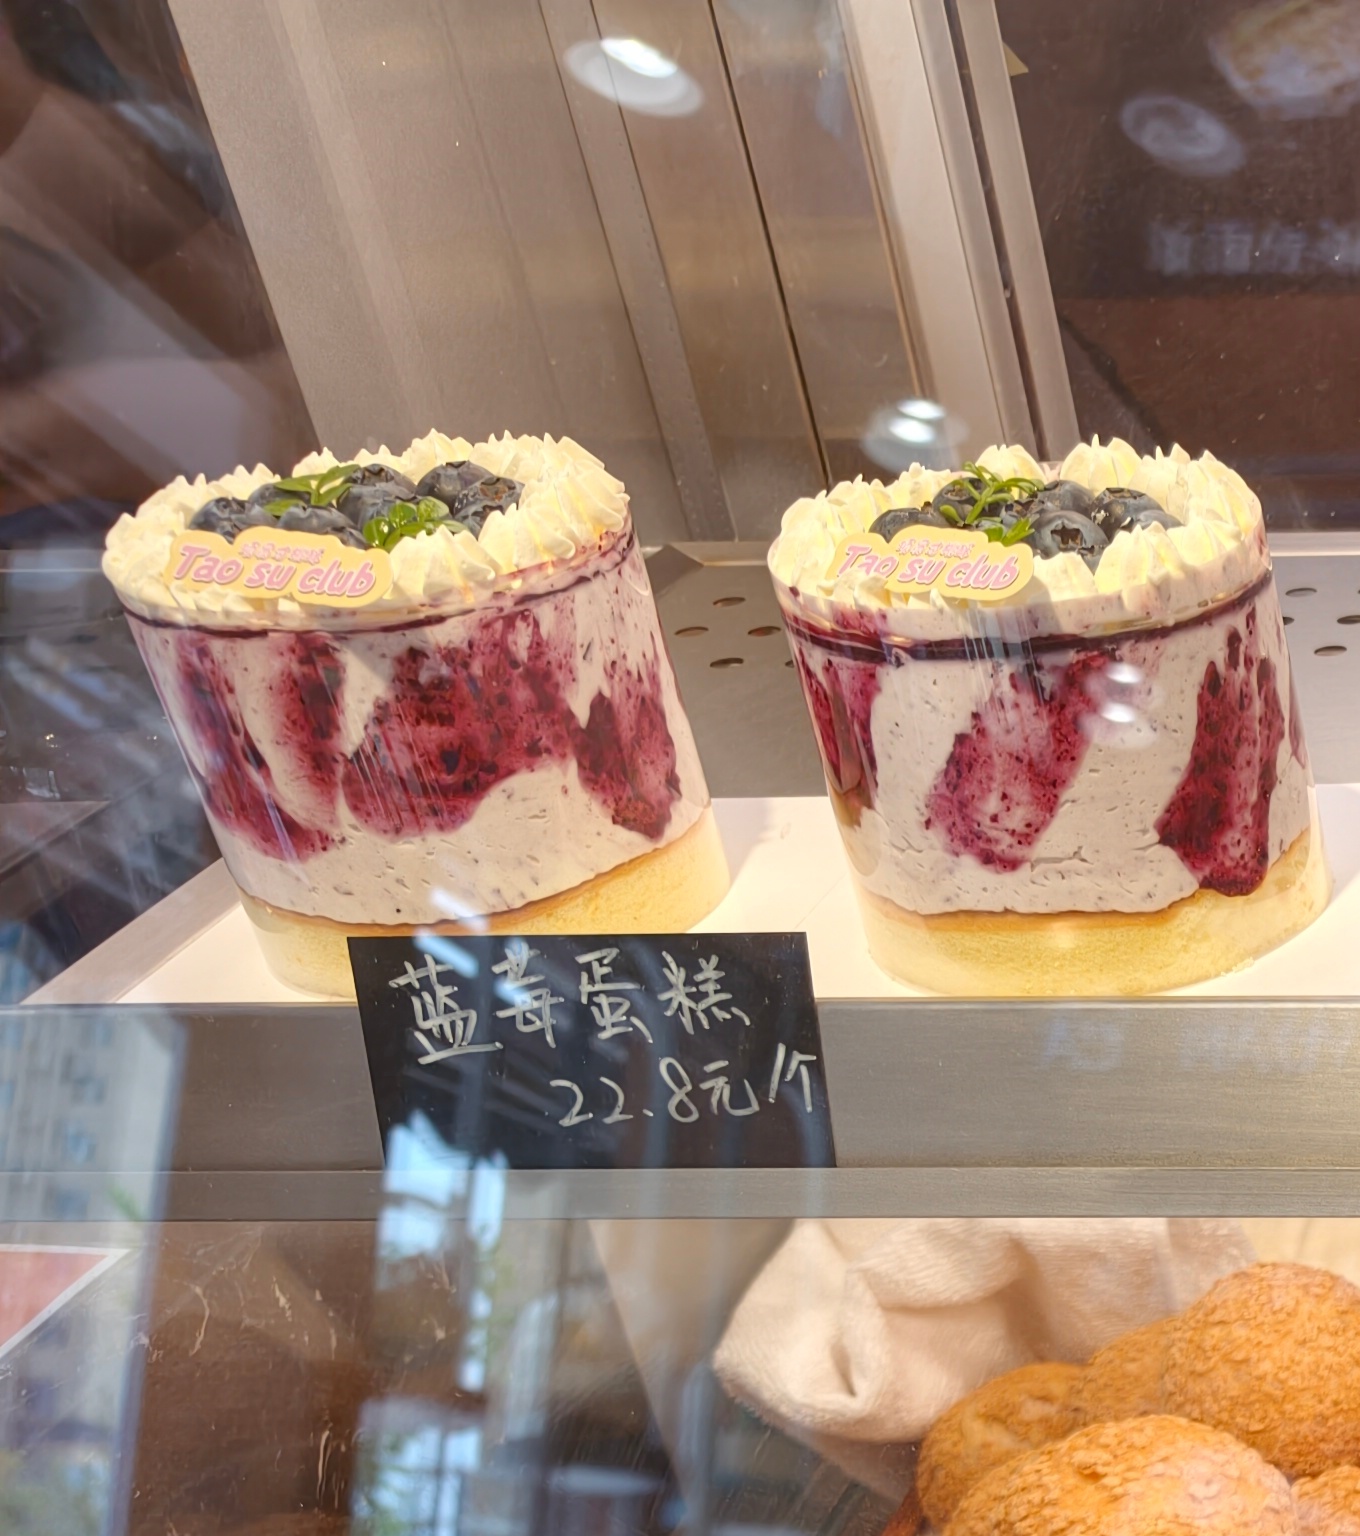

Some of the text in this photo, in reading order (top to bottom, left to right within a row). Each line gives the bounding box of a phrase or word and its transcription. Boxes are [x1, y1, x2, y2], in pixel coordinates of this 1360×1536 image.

[173, 546, 242, 581] Tao
[244, 560, 297, 591] su
[297, 559, 377, 599] club
[898, 556, 945, 586] su
[945, 553, 1019, 591] club
[388, 942, 751, 1066] 蓝莓蛋糕
[549, 1042, 817, 1128] 22.8元/个
